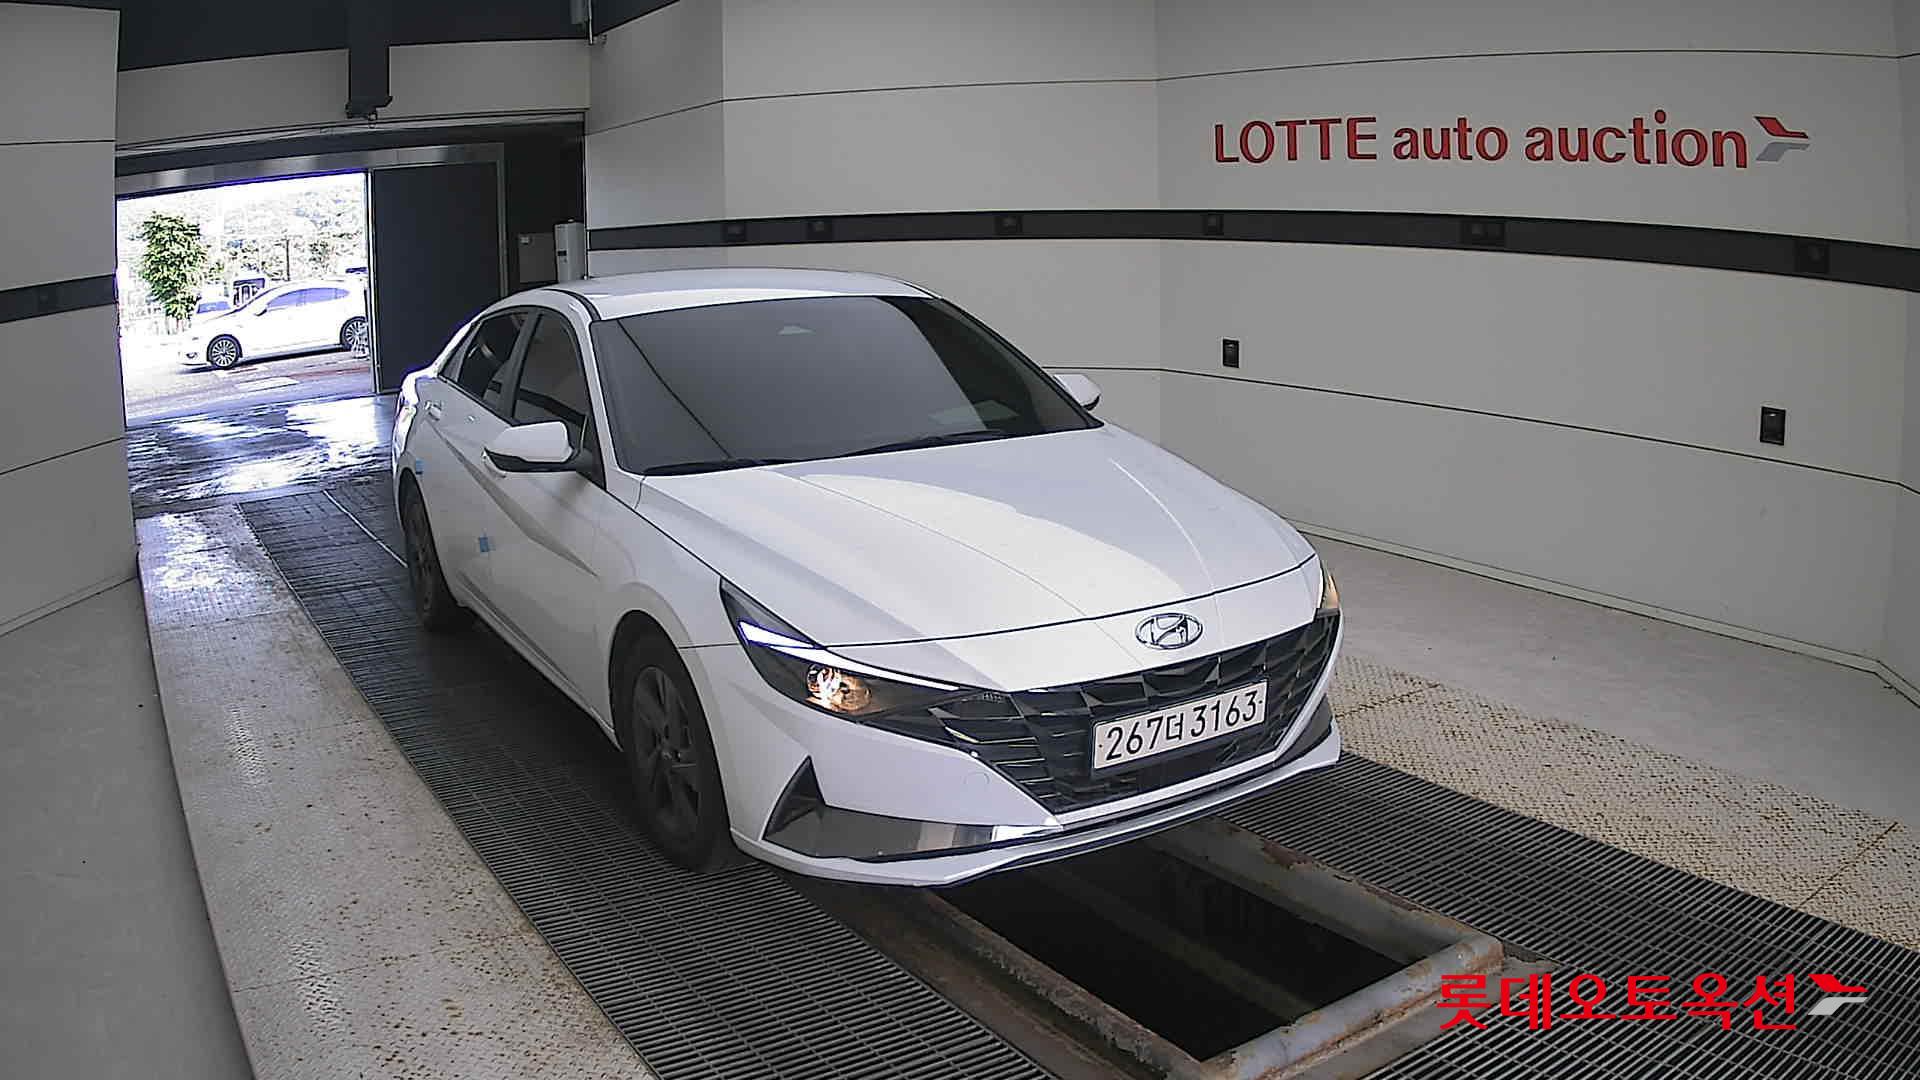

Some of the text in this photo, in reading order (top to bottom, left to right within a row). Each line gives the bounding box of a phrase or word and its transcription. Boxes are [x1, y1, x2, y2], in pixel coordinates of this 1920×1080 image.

[1214, 109, 1748, 168] LOTTE auto auction
